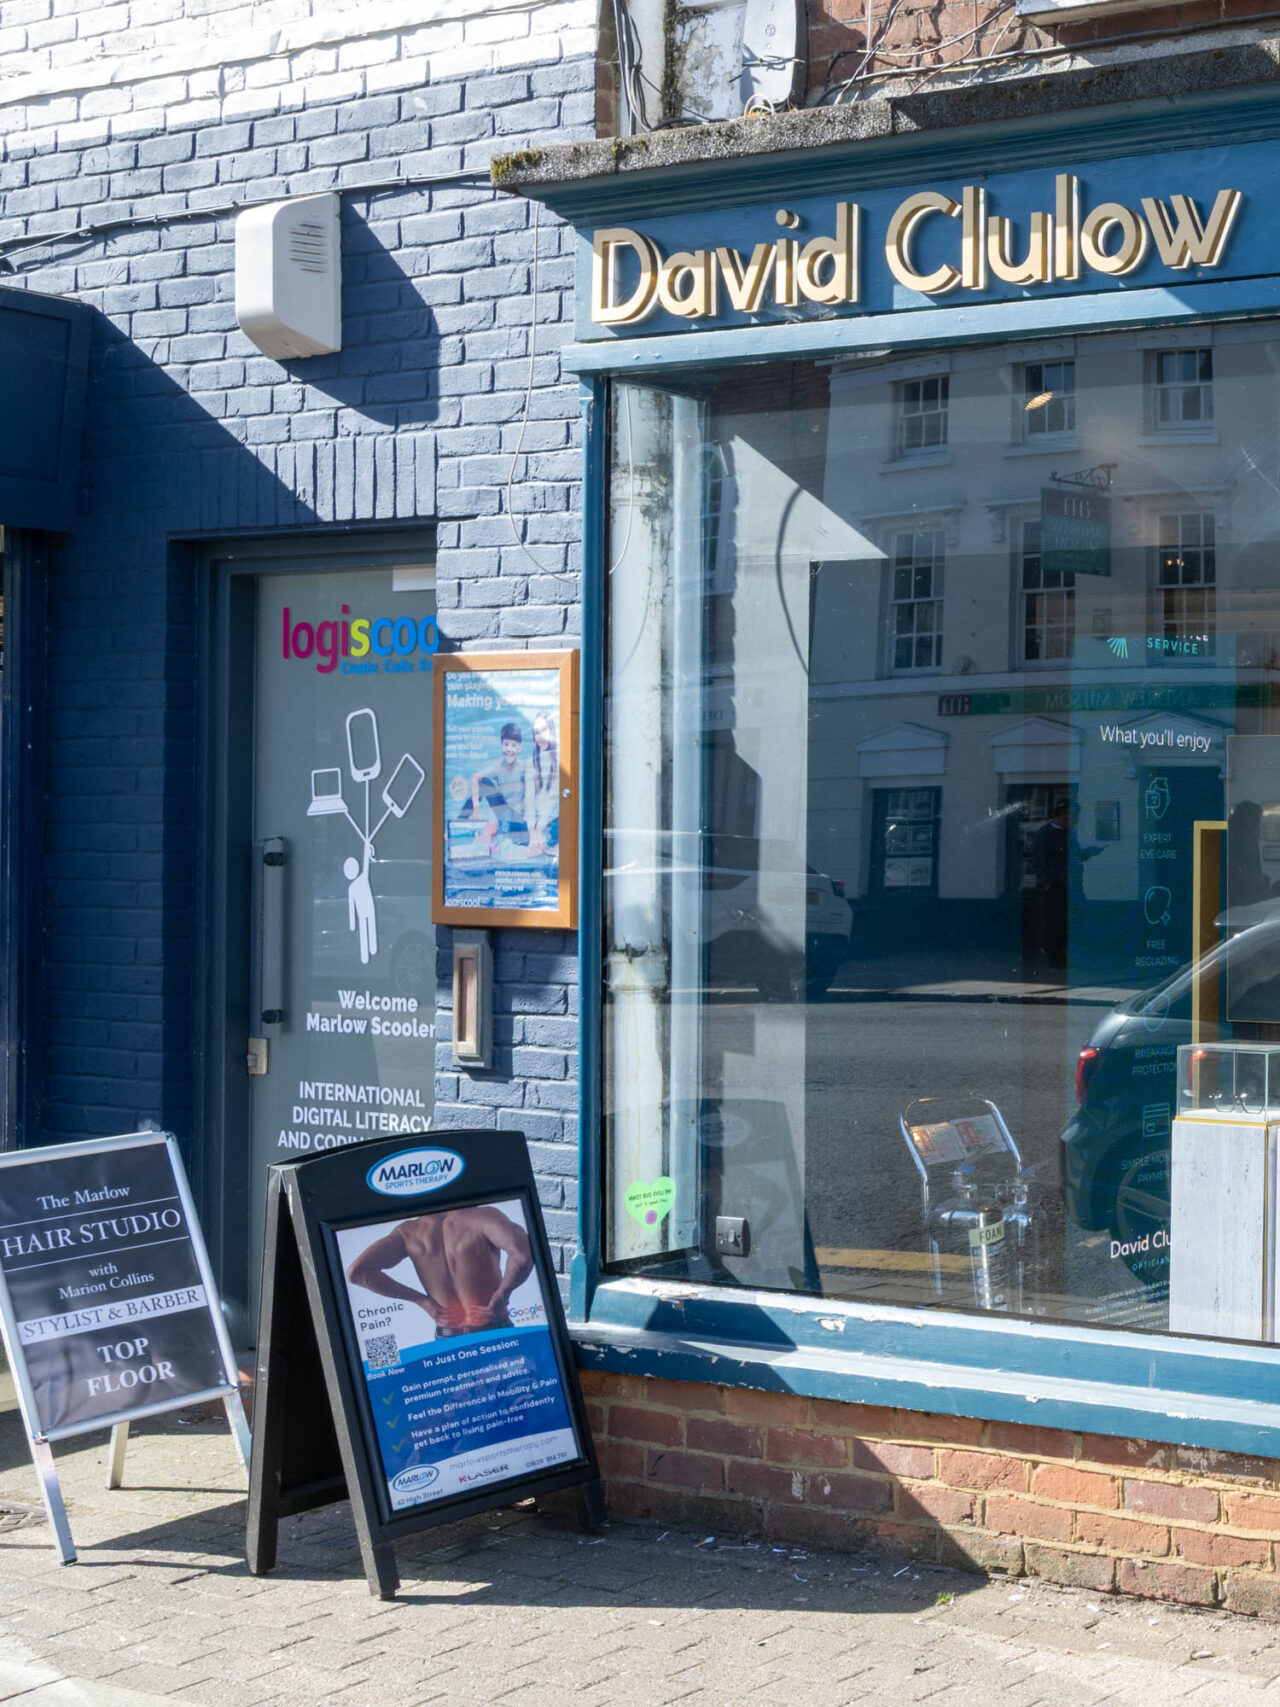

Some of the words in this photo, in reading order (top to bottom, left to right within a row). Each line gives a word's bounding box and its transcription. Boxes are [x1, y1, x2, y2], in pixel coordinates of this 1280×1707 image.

[591, 201, 861, 325] David
[885, 173, 1244, 293] Clulow
[282, 604, 440, 674] logiscoo
[1147, 637, 1198, 654] SERVICE
[419, 658, 433, 672] En
[1100, 724, 1138, 744] What
[1140, 729, 1174, 748] you'll
[1177, 732, 1211, 753] enjoy
[338, 990, 418, 1012] Welcome
[306, 1012, 367, 1034] Marlow
[371, 1017, 436, 1038] Scooler
[1132, 1062, 1177, 1075] PROTECTIO
[300, 1081, 425, 1108] INTERNATIONAL
[292, 1106, 352, 1128] DIGITAL
[355, 1111, 432, 1132] LITERACY
[278, 1130, 310, 1149] AND
[378, 1157, 455, 1182] MARLOW
[385, 1179, 413, 1190] SPORTS
[415, 1174, 448, 1186] THERAPY
[36, 1195, 70, 1210] The
[73, 1185, 130, 1205] Marlow
[1, 1228, 76, 1258] HAIR
[79, 1208, 181, 1243] STUDIO
[1110, 1234, 1150, 1258] David
[1153, 1230, 1171, 1248] Clu
[89, 1262, 118, 1278] with
[1132, 1256, 1170, 1272] OPTICIAN
[58, 1280, 107, 1300] Marion
[110, 1272, 155, 1290] Collins
[24, 1309, 104, 1339] STYLIST
[108, 1307, 122, 1321] &
[126, 1289, 200, 1316] BARBER
[358, 1302, 404, 1319] Chronic
[509, 1303, 543, 1320] Google
[360, 1317, 392, 1332] Pain?
[97, 1337, 149, 1363] TOP
[423, 1360, 433, 1368] In
[435, 1354, 456, 1366] Just
[458, 1349, 478, 1360] One
[480, 1340, 519, 1354] Session:
[87, 1361, 175, 1397] FLOOR
[367, 1371, 386, 1381] Book
[388, 1367, 405, 1376] Now
[402, 1383, 421, 1393] Gain
[457, 1362, 508, 1380] personalised
[510, 1357, 525, 1367] and
[404, 1390, 441, 1405] premium
[443, 1380, 484, 1394] treatment
[486, 1374, 501, 1384] and
[408, 1410, 426, 1421] Feel
[428, 1405, 442, 1416] the
[444, 1397, 487, 1412] Difference
[488, 1393, 496, 1401] in
[497, 1384, 530, 1399] Mobility
[532, 1381, 540, 1389] &
[540, 1378, 558, 1388] Pain
[411, 1428, 433, 1439] Have
[442, 1421, 460, 1432] plan
[462, 1417, 470, 1426] of
[471, 1411, 497, 1423] action
[499, 1408, 507, 1416] to
[509, 1395, 555, 1412] confidently
[414, 1440, 427, 1451] get
[429, 1433, 450, 1445] back
[452, 1430, 461, 1439] to
[462, 1424, 485, 1436] living
[398, 1470, 434, 1487] MARLOW
